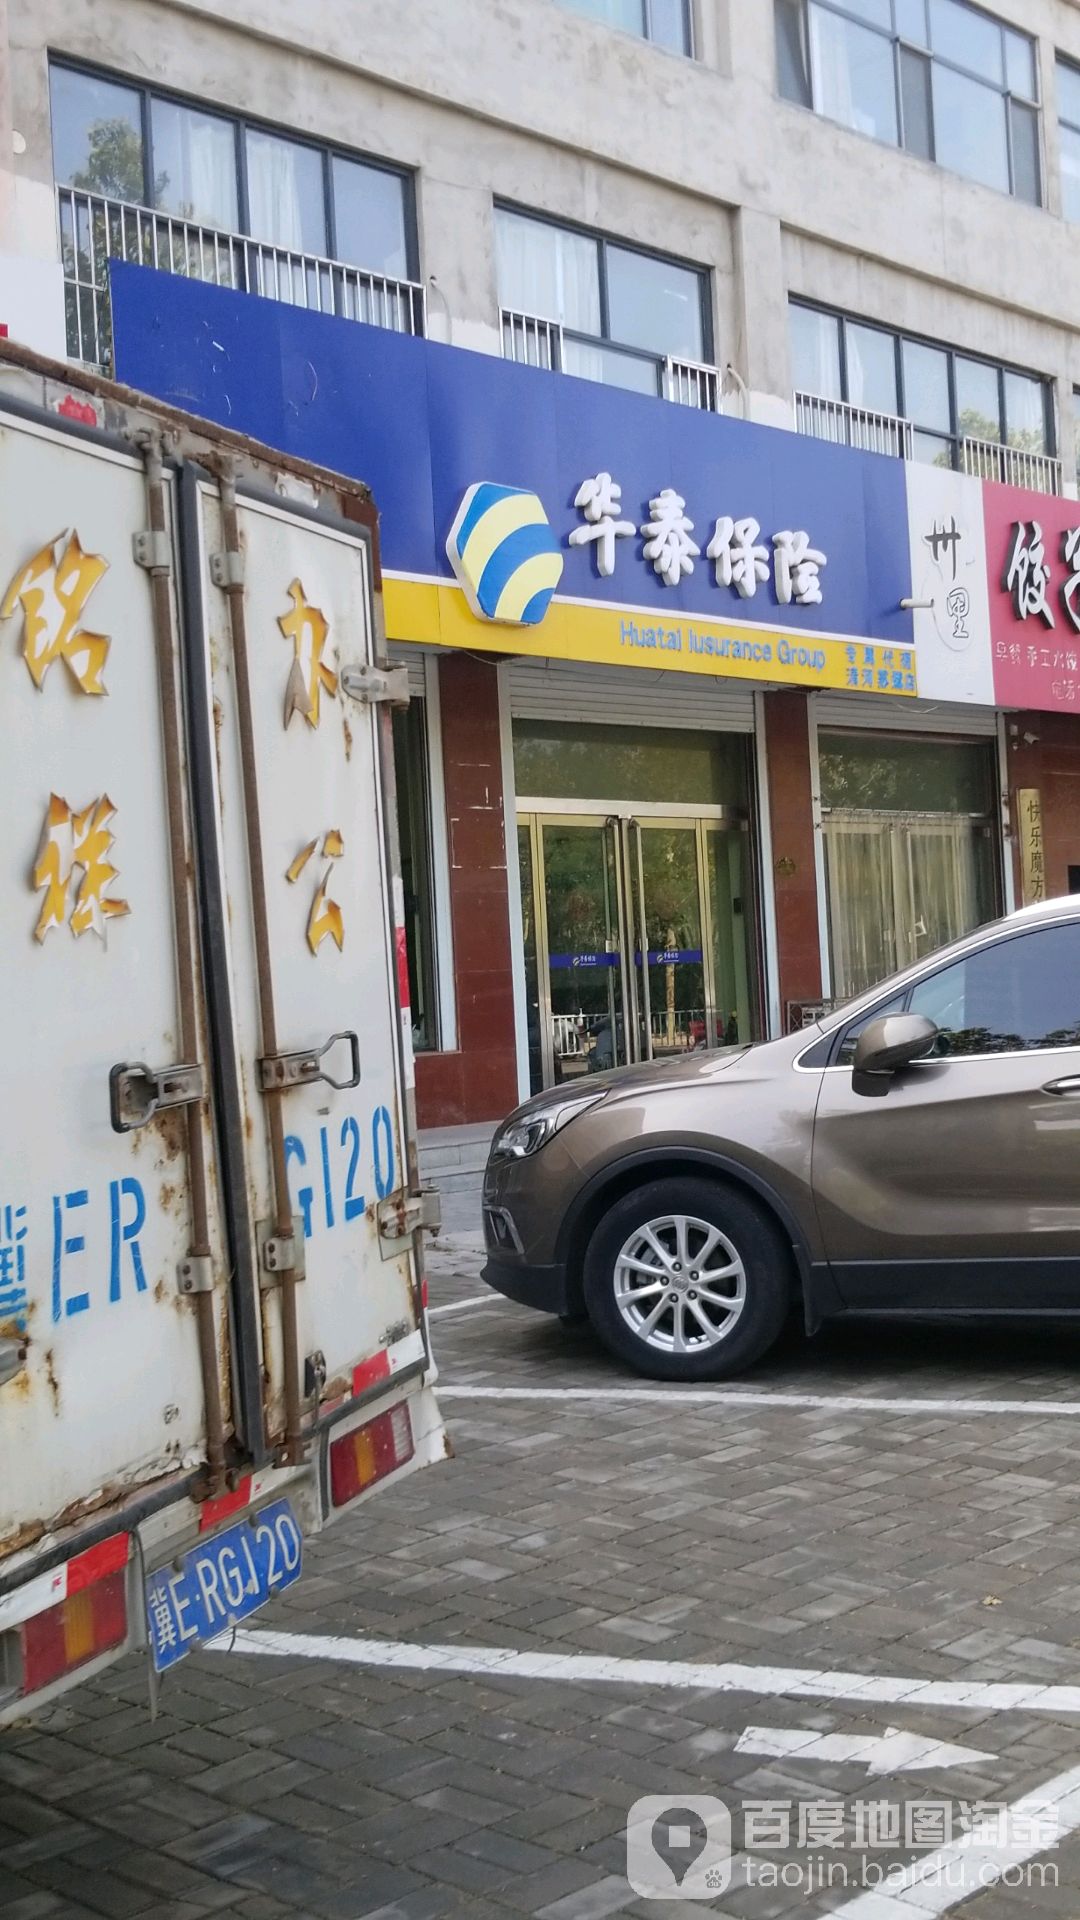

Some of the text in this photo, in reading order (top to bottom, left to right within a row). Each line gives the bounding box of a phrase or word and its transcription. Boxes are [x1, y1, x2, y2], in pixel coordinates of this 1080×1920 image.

[568, 472, 828, 604] 华泰保险
[776, 639, 826, 673] Group
